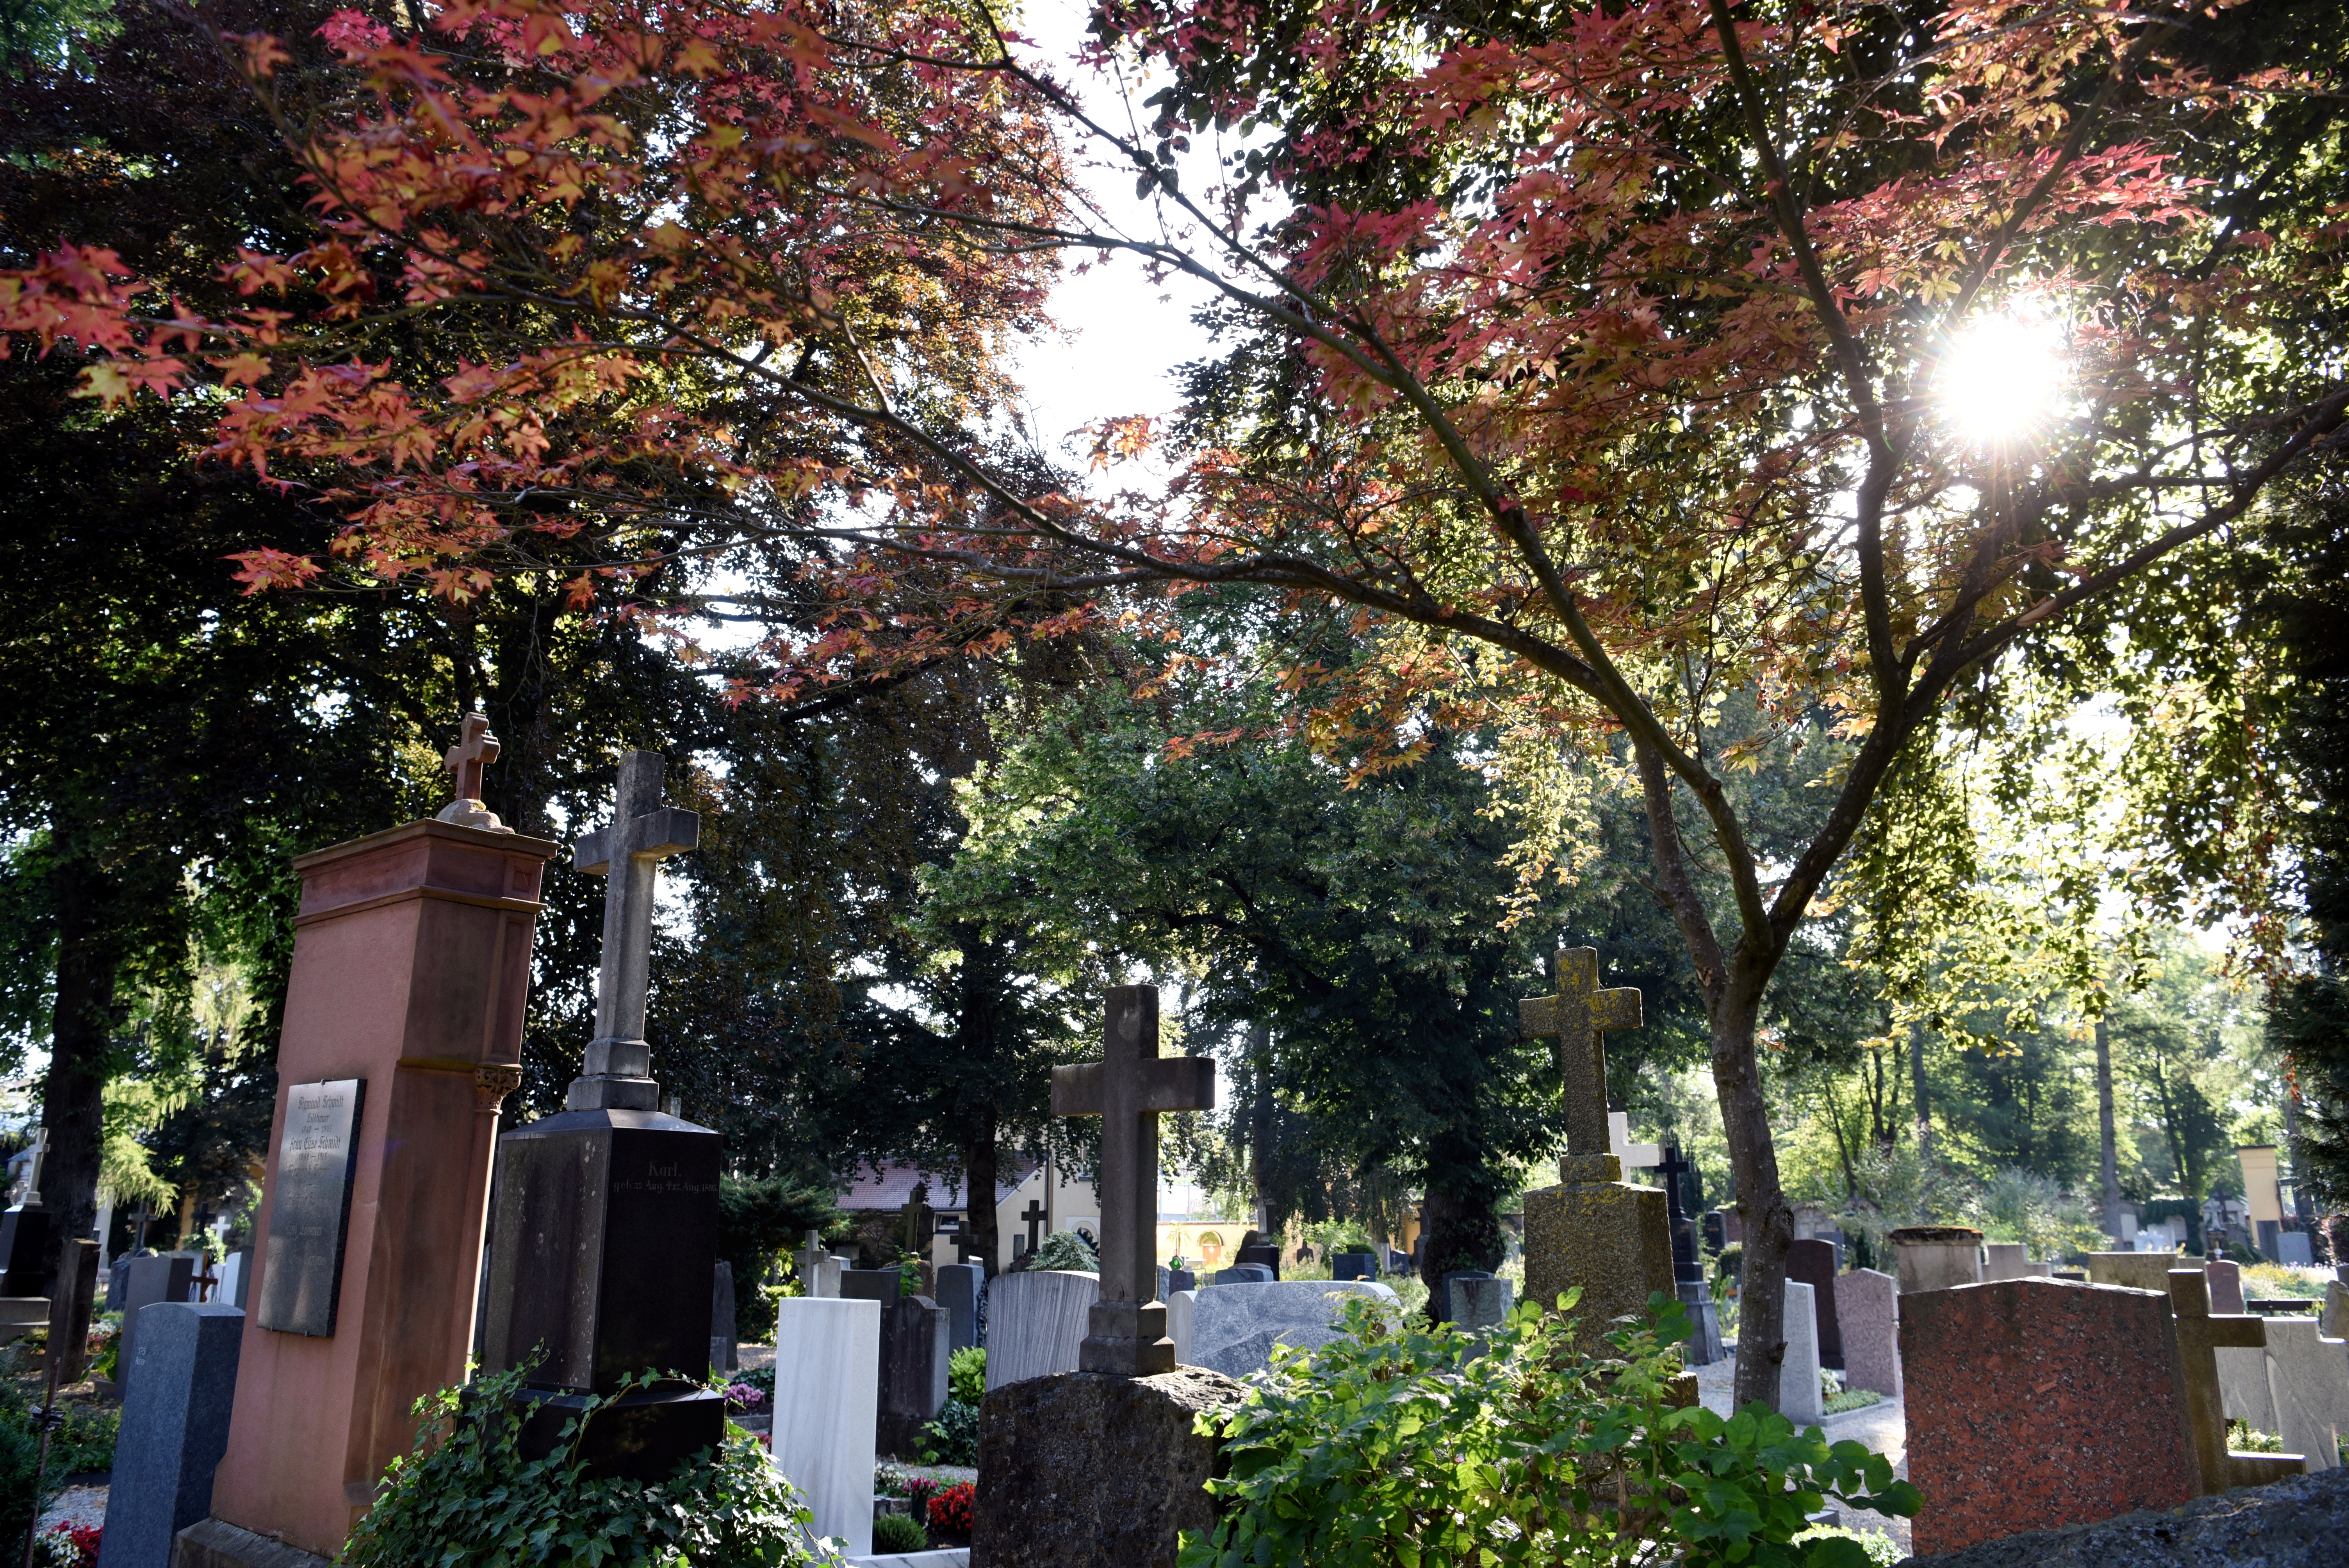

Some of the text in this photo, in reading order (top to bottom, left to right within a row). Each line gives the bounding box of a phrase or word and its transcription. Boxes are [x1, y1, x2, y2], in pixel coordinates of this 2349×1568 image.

[322, 1095, 344, 1110] Schmidt
[304, 1137, 317, 1150] Elise
[318, 1135, 341, 1149] Schmidt
[614, 1180, 633, 1193] geb.
[646, 1180, 665, 1194] Aug.
